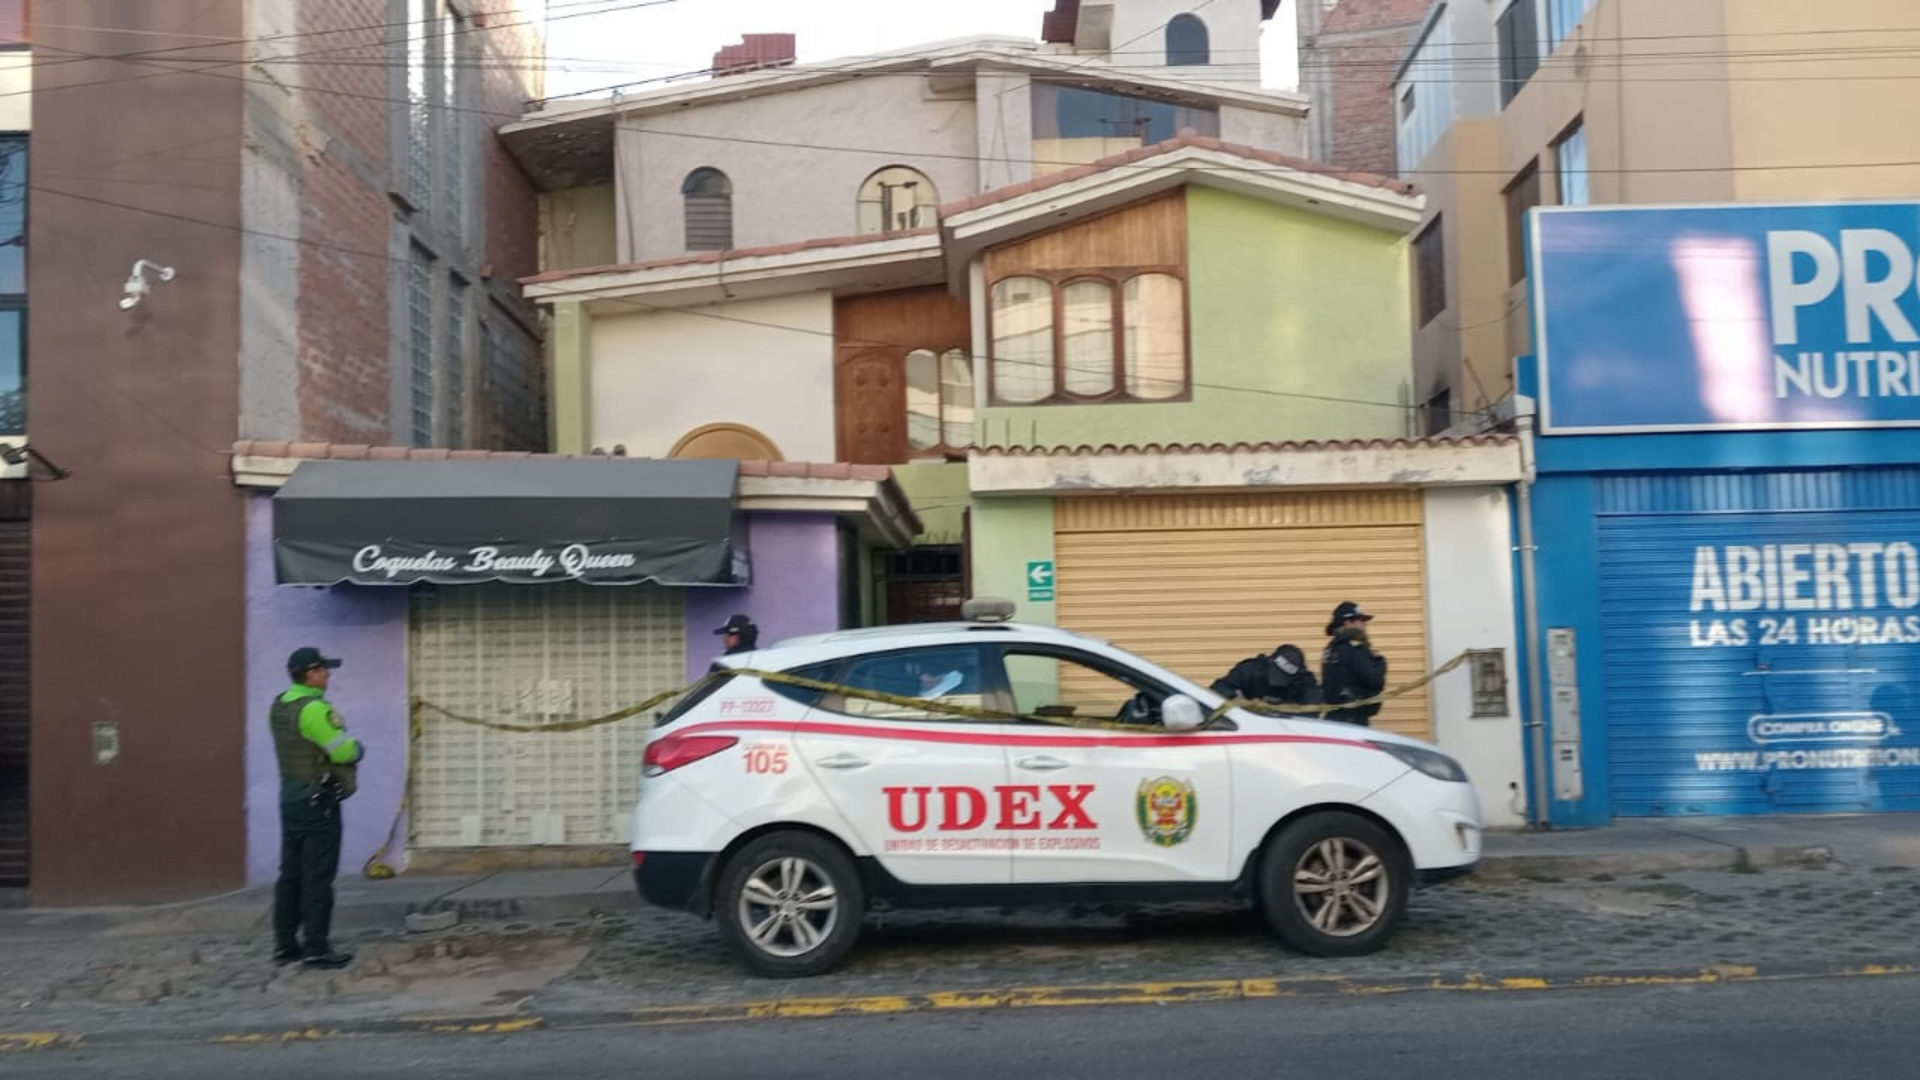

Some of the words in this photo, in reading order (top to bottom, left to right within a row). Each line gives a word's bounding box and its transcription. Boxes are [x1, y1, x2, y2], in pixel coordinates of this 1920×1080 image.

[1767, 228, 1920, 345] PR
[463, 546, 555, 576] Beauty
[559, 543, 636, 578] Queen
[1689, 541, 1920, 612] ABIERTO
[1690, 617, 1749, 647] LAS
[1758, 616, 1798, 645] 24
[1807, 614, 1920, 645] HORAS
[741, 750, 789, 774] 105
[881, 784, 1098, 833] UDEX
